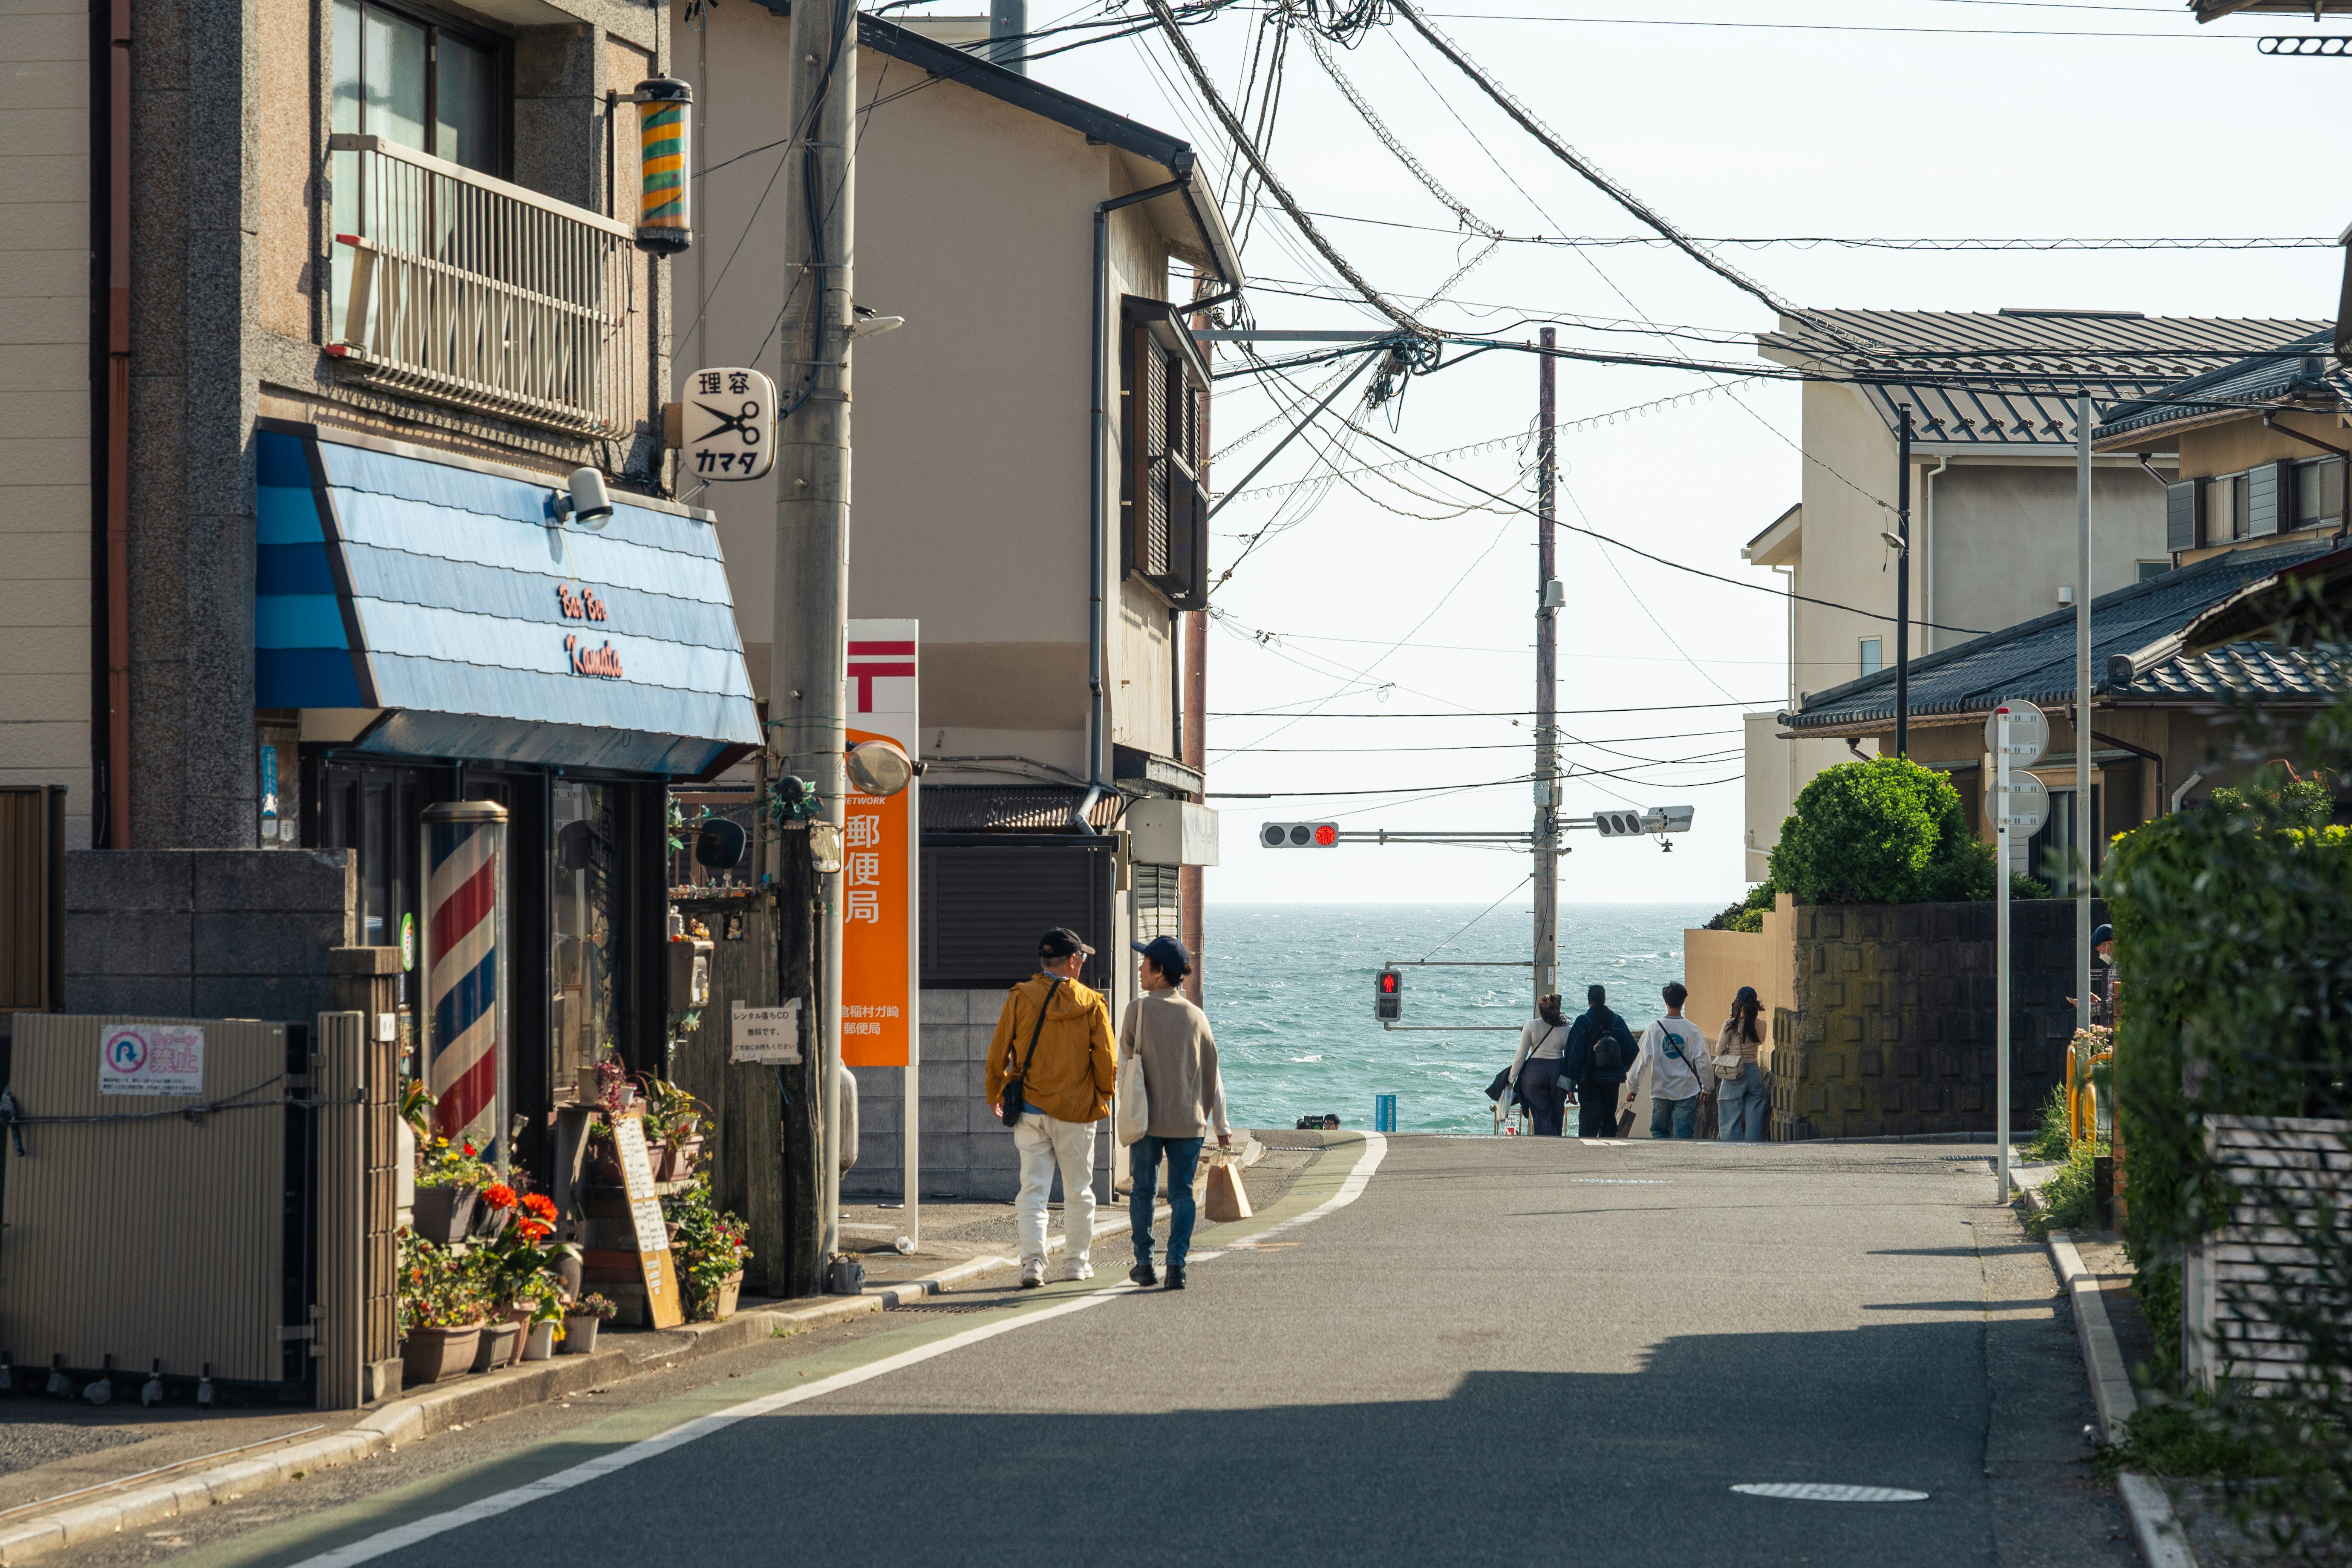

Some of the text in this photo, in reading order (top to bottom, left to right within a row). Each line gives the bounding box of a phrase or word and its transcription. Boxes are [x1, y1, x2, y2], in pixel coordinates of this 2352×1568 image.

[699, 372, 749, 395] 理容
[695, 448, 758, 474] カマタ
[845, 814, 880, 924] 郵便局
[734, 1012, 789, 1020] レンタル落ちCD
[748, 1028, 780, 1036] 無料です。
[843, 1022, 881, 1035] 郵便局
[150, 1046, 199, 1073] 禁止
